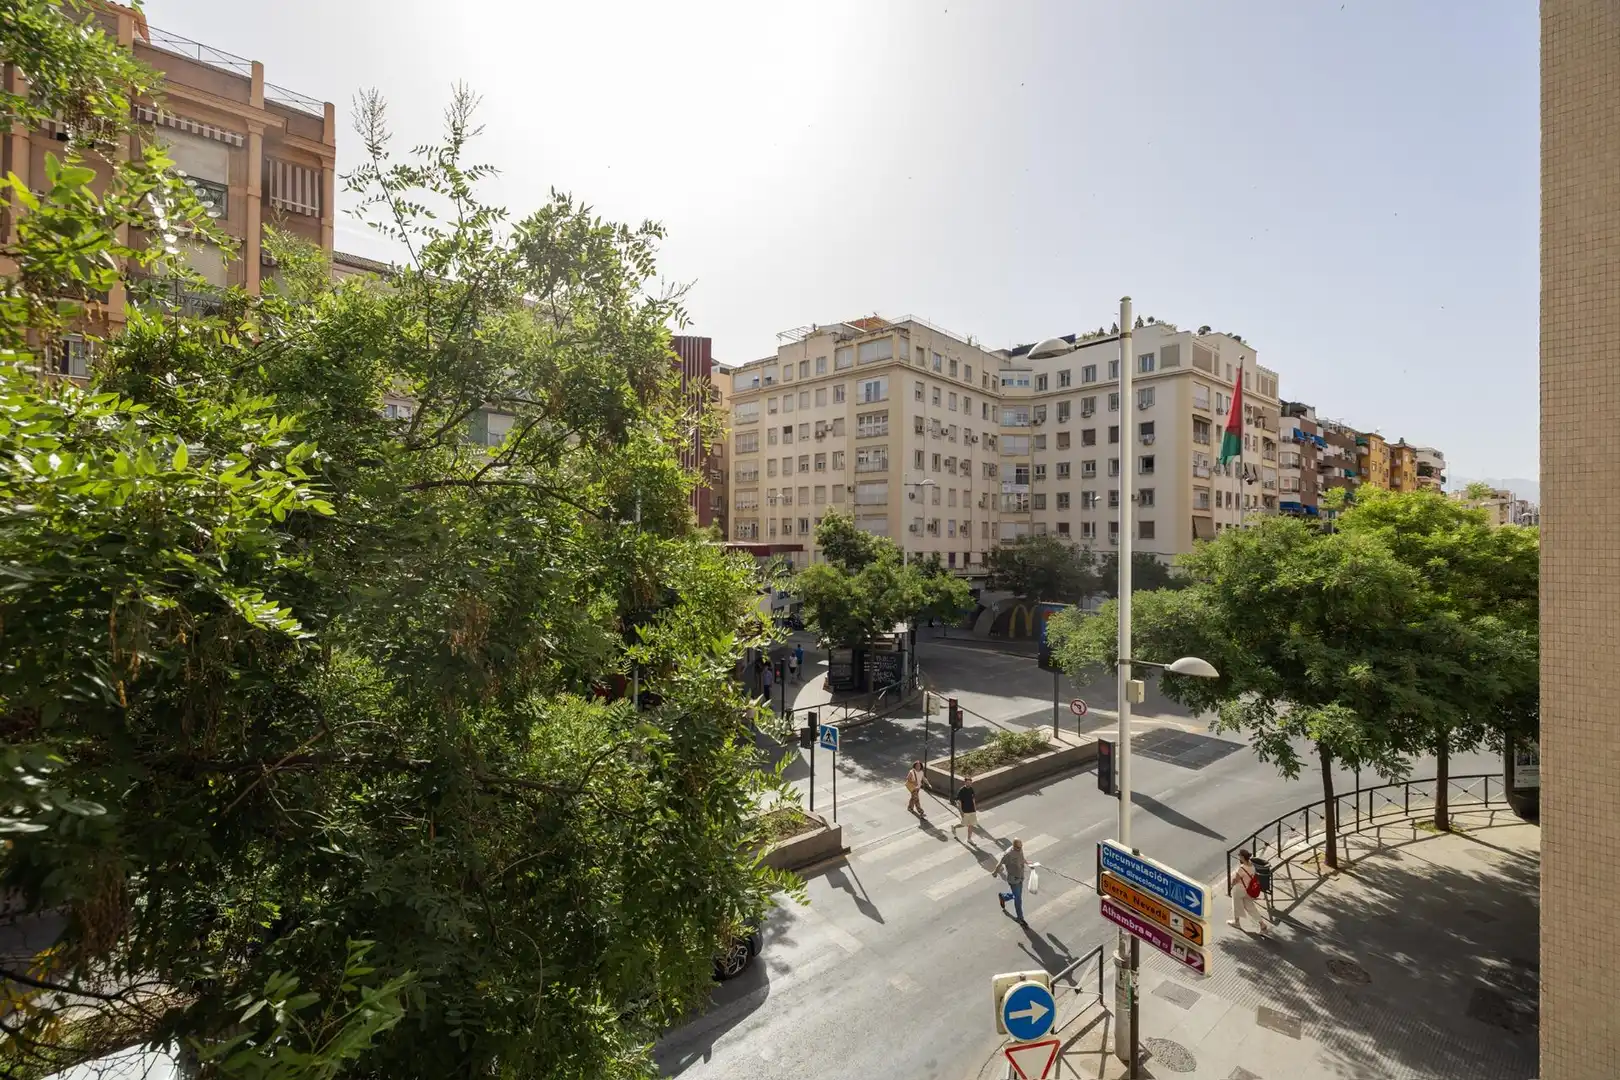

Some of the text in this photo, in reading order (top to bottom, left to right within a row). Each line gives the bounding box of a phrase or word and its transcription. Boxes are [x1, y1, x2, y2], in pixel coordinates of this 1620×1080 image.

[1103, 847, 1169, 885] Circunvalación
[1103, 857, 1169, 896] (todas direcciones)
[1103, 879, 1168, 921] Sierra Nevada
[1102, 904, 1145, 935] Alhambra
